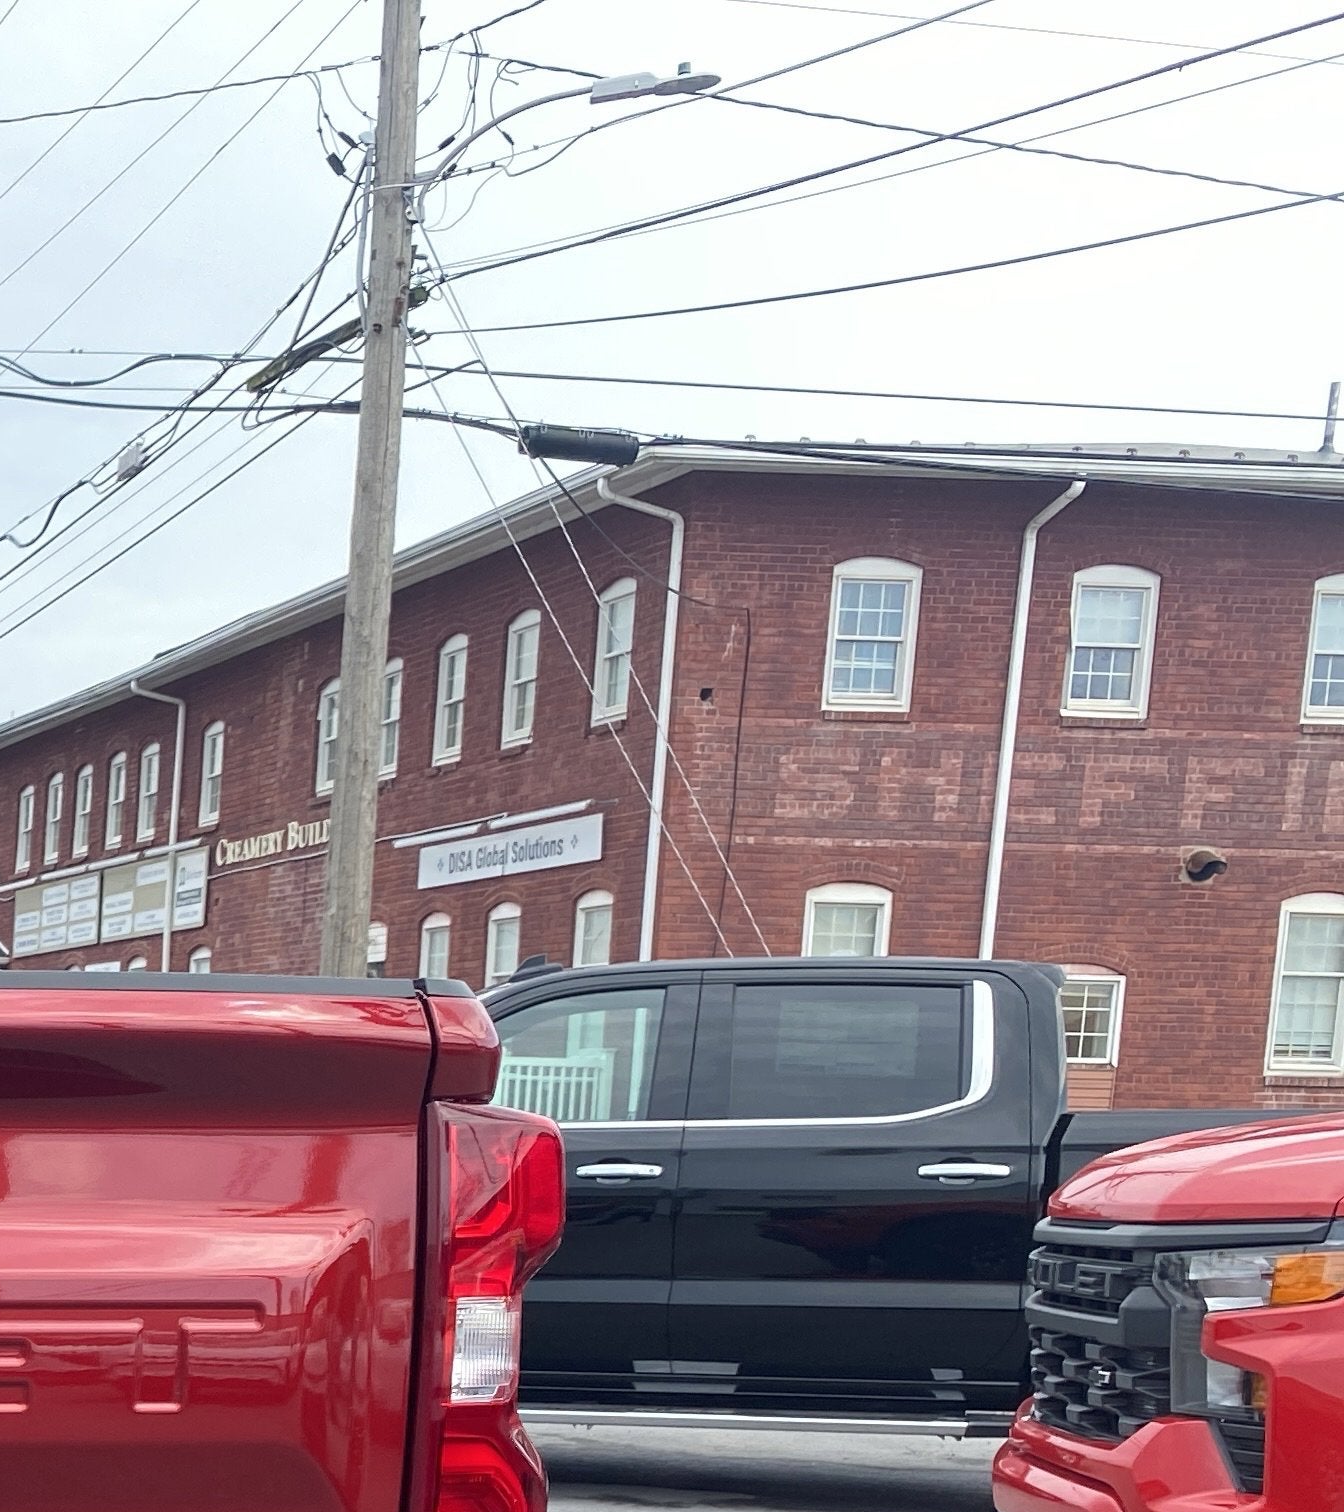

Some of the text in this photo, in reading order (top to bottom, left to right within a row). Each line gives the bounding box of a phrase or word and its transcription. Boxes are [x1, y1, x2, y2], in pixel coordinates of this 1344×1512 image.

[773, 747, 1344, 833] SHEFFI
[286, 819, 331, 850] BUILD
[448, 836, 564, 875] DISA Global Solutions
